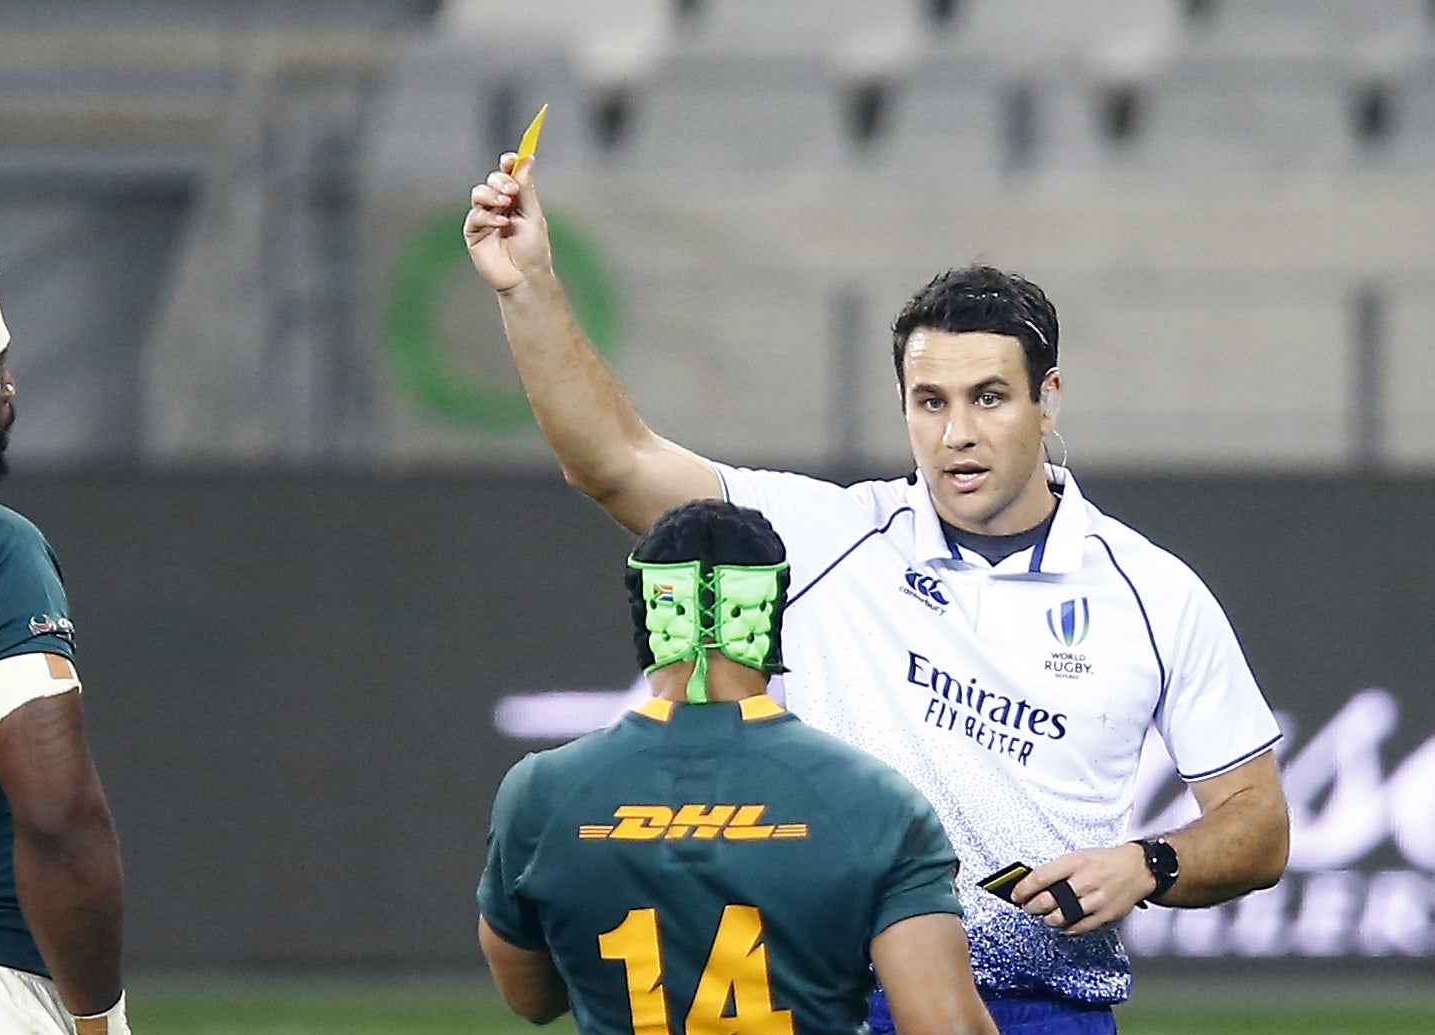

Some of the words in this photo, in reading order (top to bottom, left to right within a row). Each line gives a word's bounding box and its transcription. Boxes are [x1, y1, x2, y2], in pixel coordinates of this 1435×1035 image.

[1044, 660, 1092, 674] RUGBY
[1051, 652, 1086, 661] WORLD
[907, 650, 1068, 740] Emirates
[924, 698, 958, 731] FLY
[965, 716, 1034, 767] BETTER
[609, 804, 775, 840] DHL
